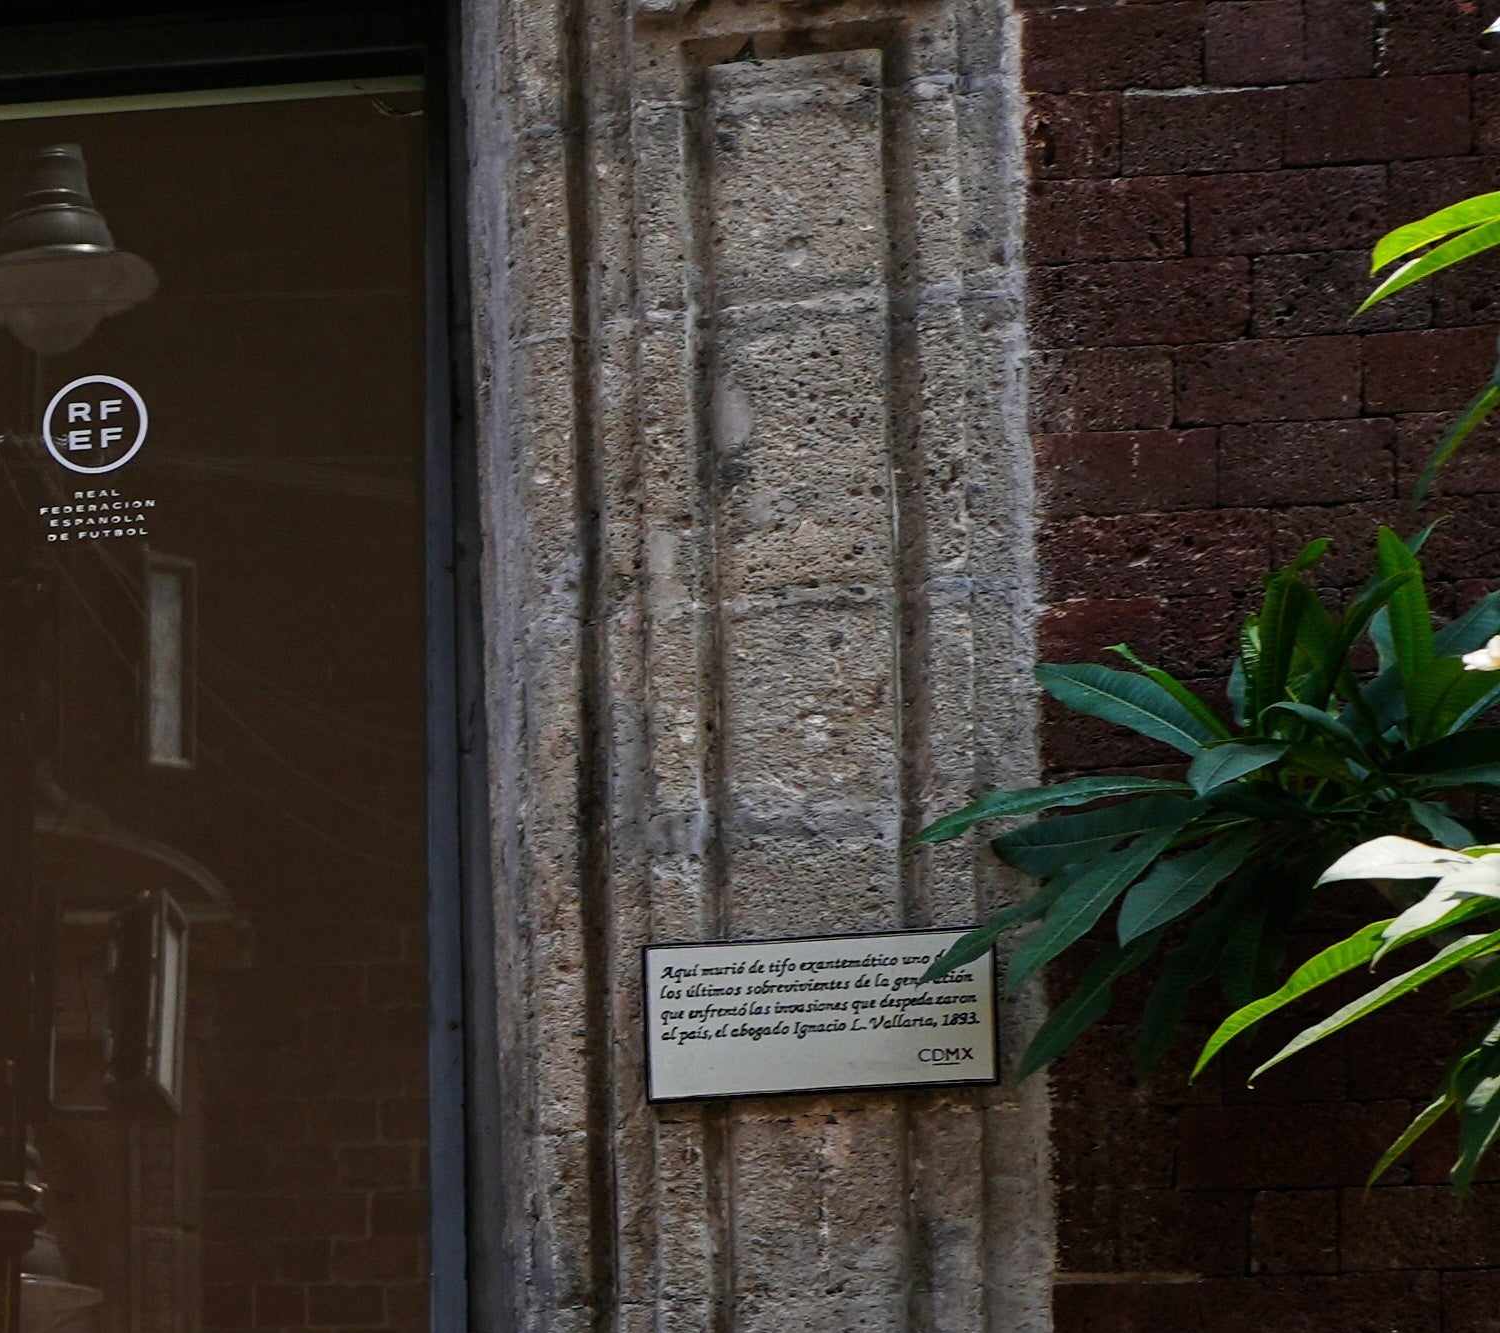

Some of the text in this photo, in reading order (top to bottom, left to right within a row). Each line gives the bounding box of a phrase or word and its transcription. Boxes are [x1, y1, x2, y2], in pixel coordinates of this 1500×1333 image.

[74, 488, 120, 499] REAL
[47, 532, 69, 542] DE
[660, 964, 699, 983] Aquí
[700, 961, 747, 976] murió
[748, 959, 765, 974] de
[768, 957, 796, 977] tifo
[799, 953, 898, 974] exantemático
[902, 955, 930, 965] uno
[660, 973, 890, 999] los últimos sobrevivientes de la
[660, 991, 978, 1026] que enfrentó las invasiones que despedazaron
[678, 1025, 712, 1046] país,
[714, 1023, 729, 1038] el
[730, 1020, 790, 1041] abogado
[792, 1019, 847, 1039] Ignacio
[869, 1013, 938, 1030] Vallarta,
[941, 1012, 981, 1027] 1893.
[917, 1047, 974, 1063] CDMX
